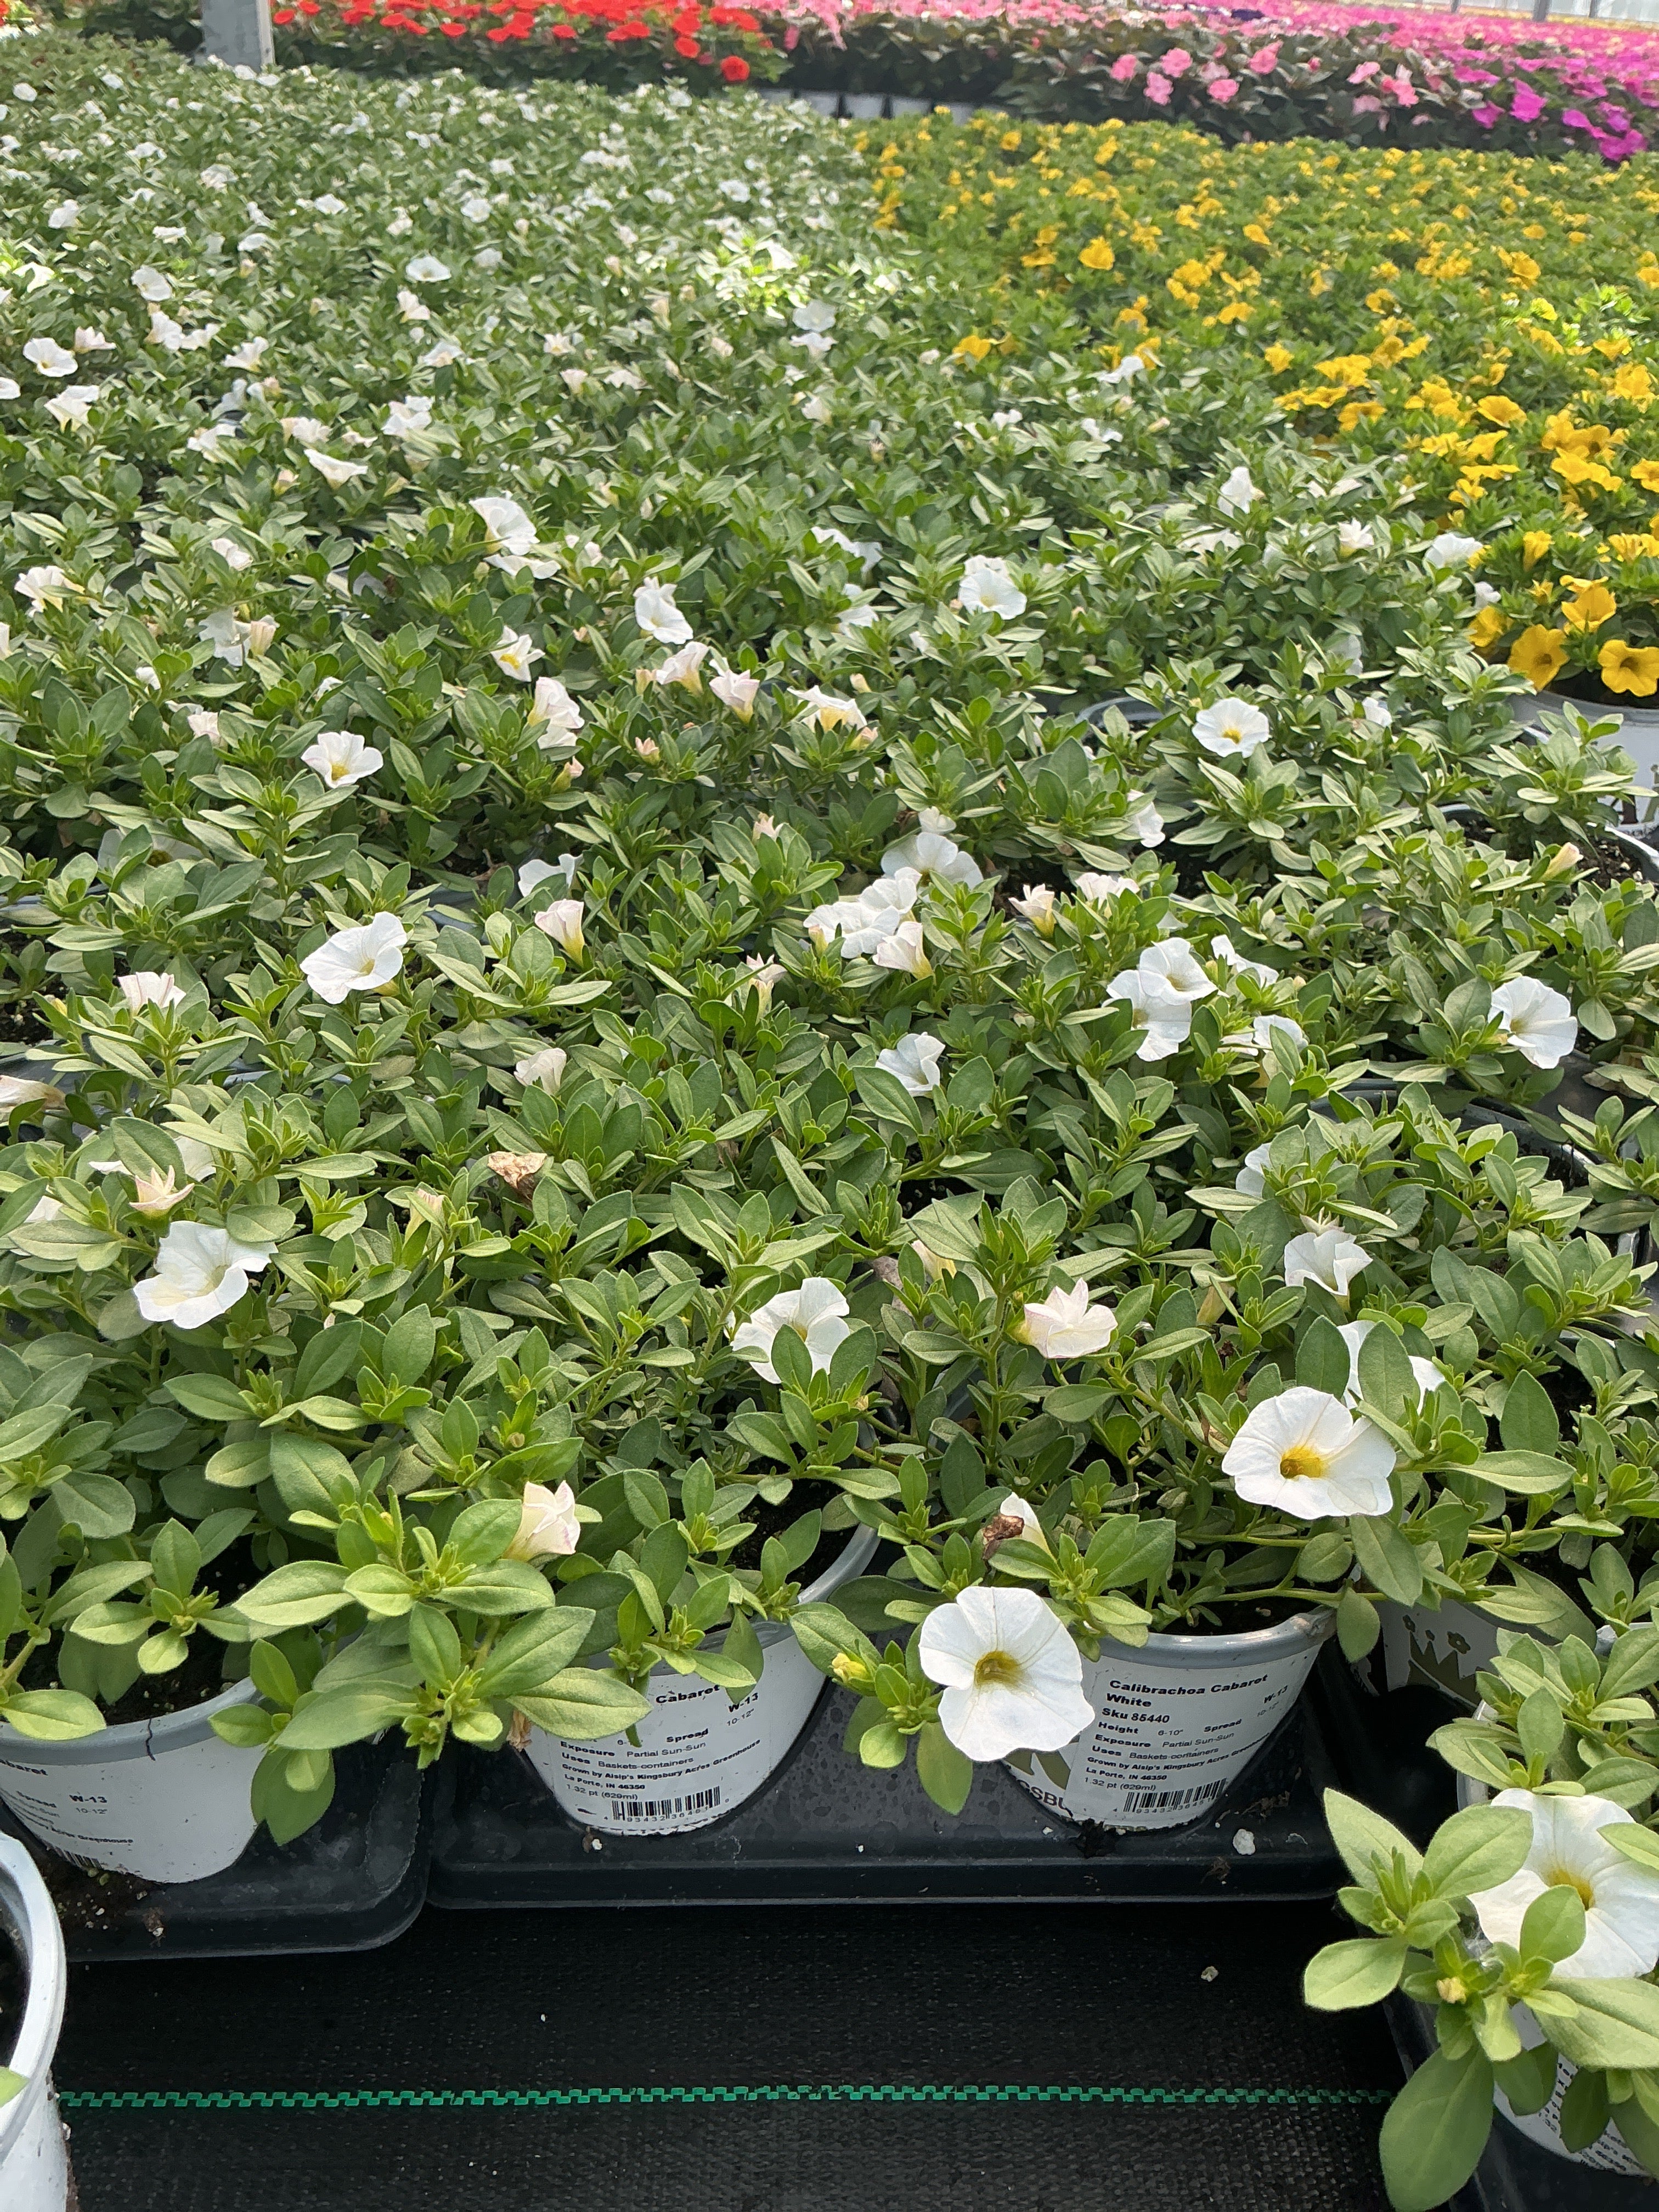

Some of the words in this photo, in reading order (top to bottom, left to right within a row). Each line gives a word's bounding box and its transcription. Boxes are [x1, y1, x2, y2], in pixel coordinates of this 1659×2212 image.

[1109, 1680, 1205, 1695] Calibrachoa
[1210, 1674, 1268, 1693] Cabaret
[656, 1684, 720, 1703] Cabaret
[1106, 1692, 1152, 1707] White
[1263, 1685, 1288, 1703] W-13
[728, 1692, 759, 1712] W-13
[1101, 1708, 1128, 1719] Sku
[1131, 1713, 1170, 1723] 85440
[1098, 1721, 1139, 1734] Height
[1204, 1718, 1242, 1733] Spread
[666, 1728, 709, 1743] Spread
[1094, 1734, 1151, 1748] Exposure
[1194, 1733, 1234, 1746] Sun-Sun
[560, 1741, 616, 1757] Exposure
[661, 1742, 706, 1756] Sun-Sun
[1092, 1745, 1122, 1756] Uses
[561, 1752, 591, 1764] Uses
[562, 1764, 590, 1775] Grown
[592, 1770, 602, 1779] by
[637, 1770, 682, 1780] Kingsbury
[685, 1763, 710, 1774] Acres
[713, 1739, 760, 1765] Greenhouse
[1087, 1757, 1116, 1767] Grown
[1163, 1760, 1205, 1770] Kingsbury
[1206, 1754, 1229, 1764] Acres
[1085, 1777, 1104, 1786] 1.32
[1099, 1770, 1125, 1780] Porte,
[577, 1778, 603, 1788] Porte,
